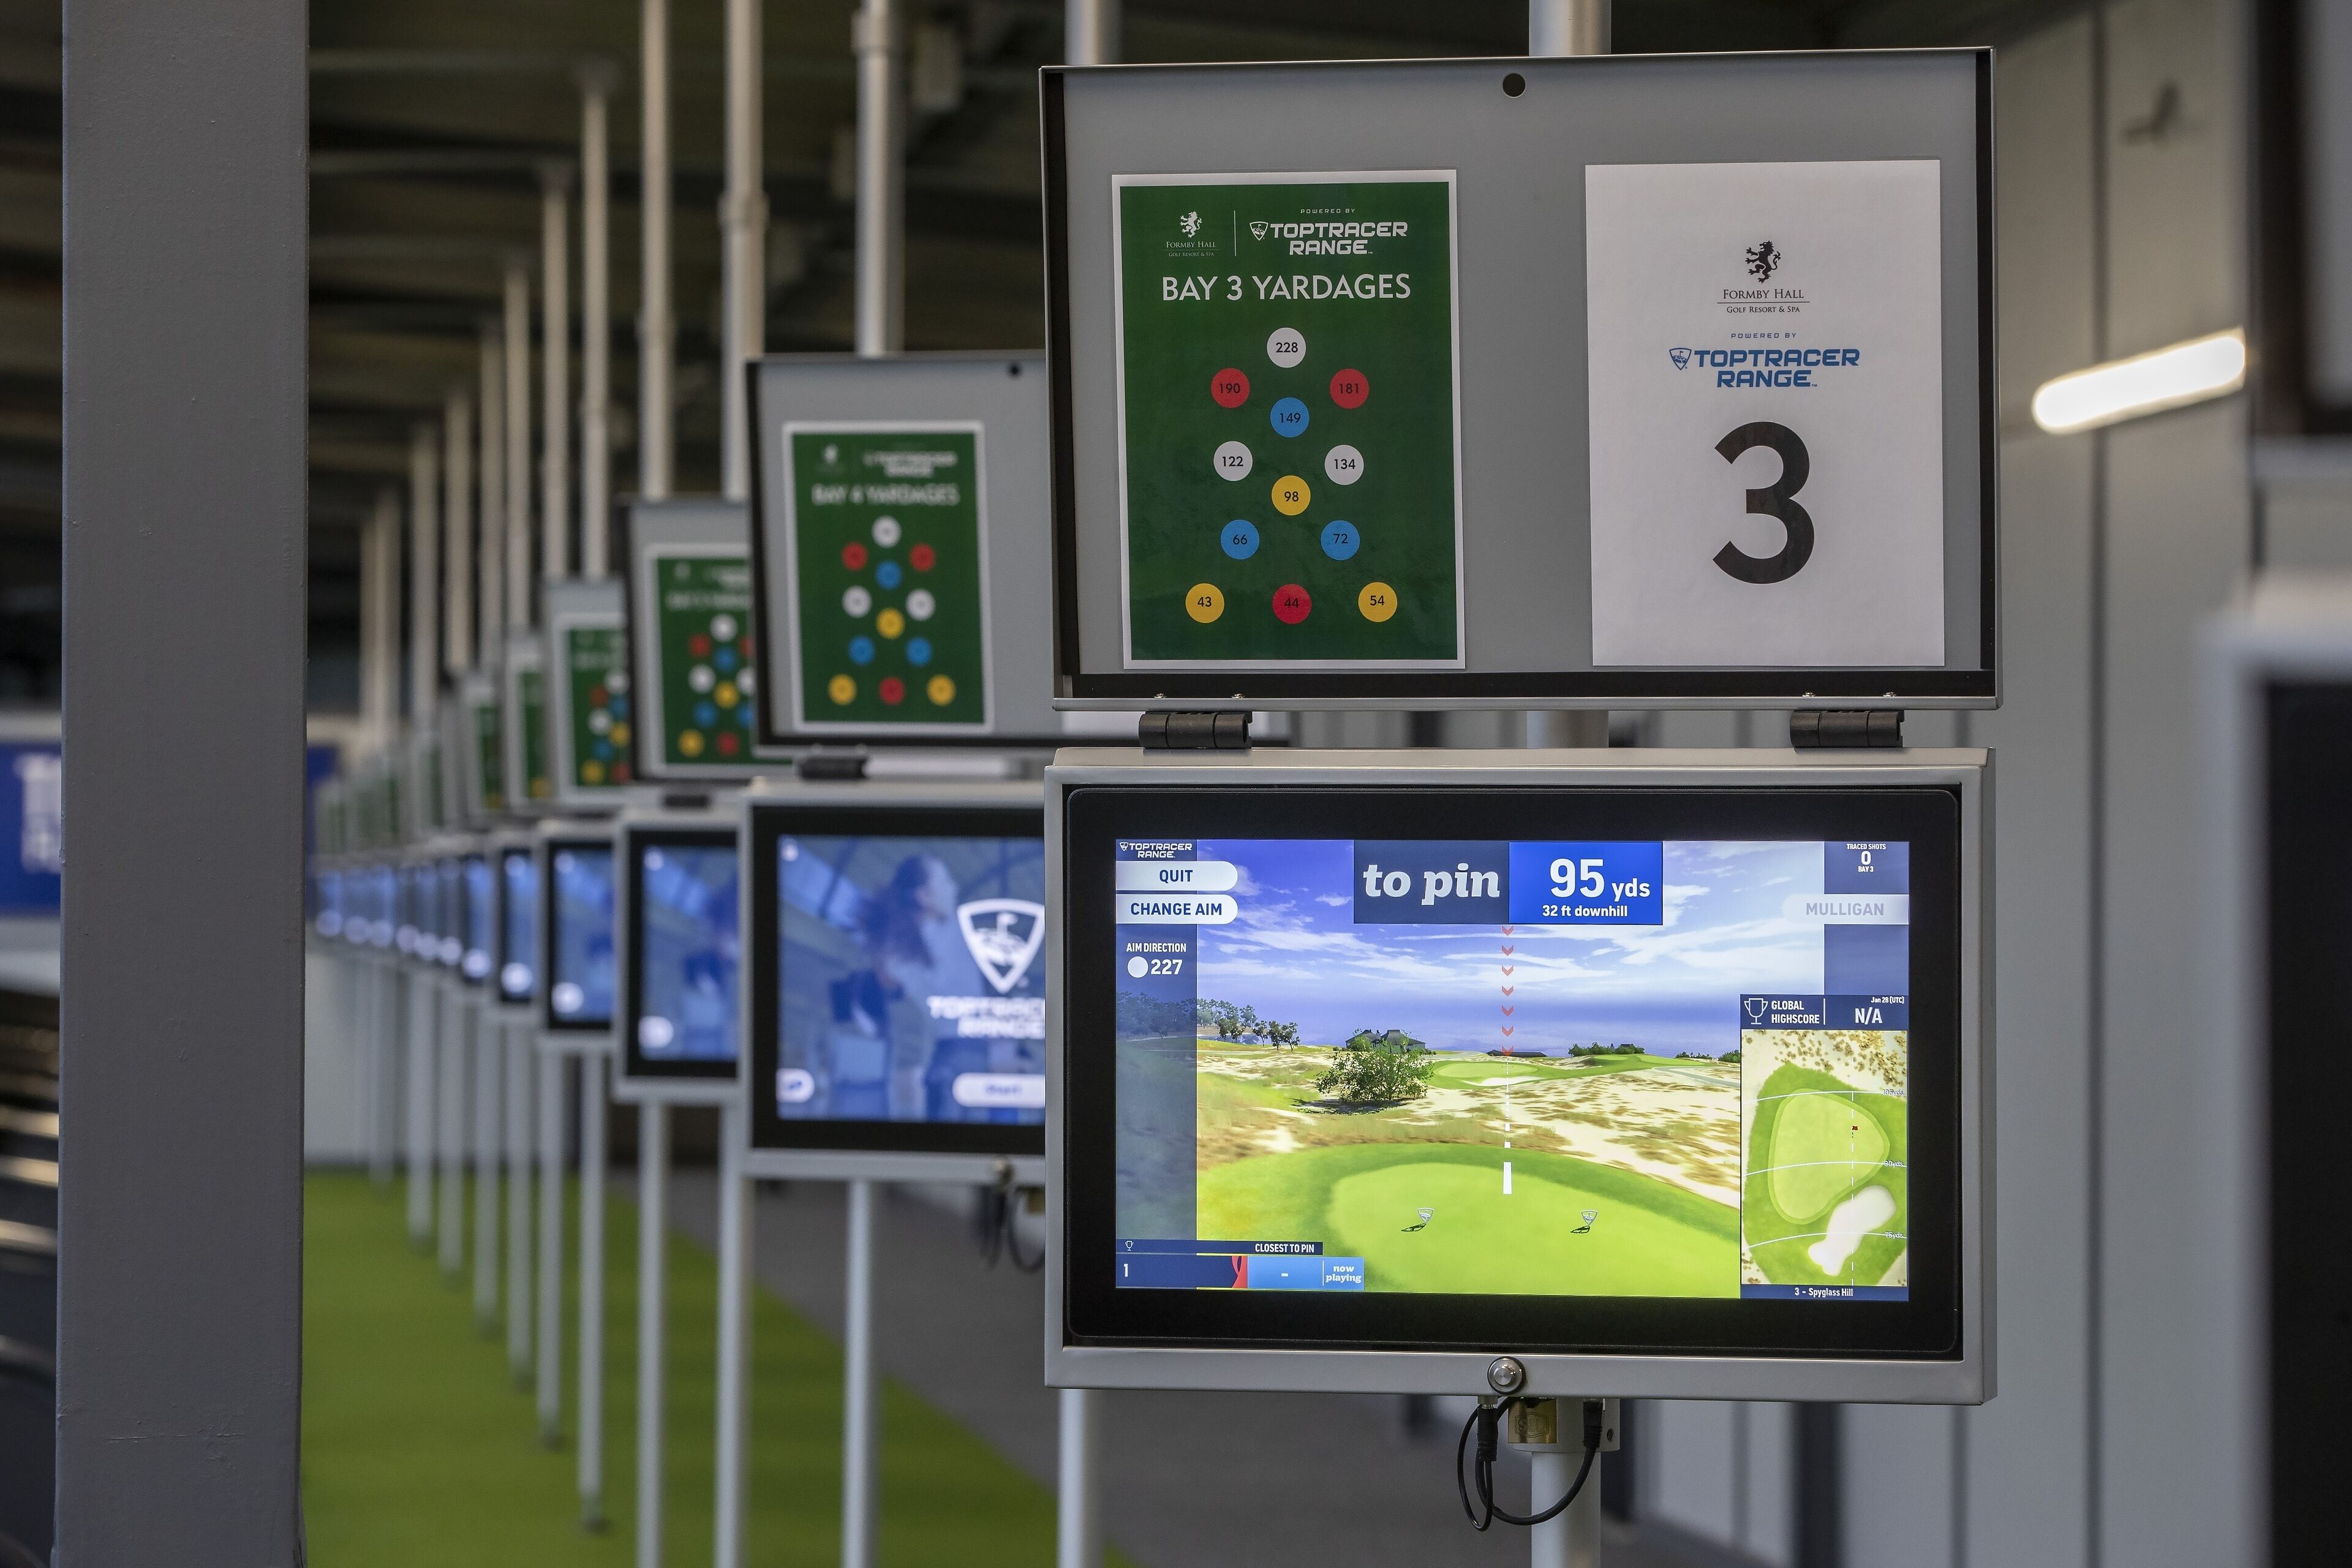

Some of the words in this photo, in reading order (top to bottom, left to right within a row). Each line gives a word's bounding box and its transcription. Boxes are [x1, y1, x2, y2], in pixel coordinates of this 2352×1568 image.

[1270, 222, 1408, 238] TOPTRACER
[1289, 239, 1368, 255] RANGE
[1163, 276, 1218, 301] BAY
[1227, 275, 1242, 300] 3
[1251, 273, 1411, 300] YARDAGES
[1723, 289, 1770, 300] FORMBY
[1774, 288, 1804, 300] HALL
[1275, 342, 1298, 353] 228
[1694, 349, 1860, 368] TOPTRACER
[1716, 370, 1812, 388] RANGE
[1219, 383, 1241, 394] 190
[1339, 383, 1360, 394] 181
[1280, 413, 1301, 424] 149
[1222, 456, 1244, 467] 122
[1334, 459, 1356, 470] 134
[1284, 491, 1299, 502] 98
[1713, 421, 1815, 584] 3
[1232, 534, 1248, 545] 66
[1333, 533, 1348, 544] 72
[1197, 597, 1212, 608] 43
[1284, 598, 1299, 609] 44
[1370, 595, 1385, 606] 54
[1159, 869, 1193, 883] QUIT
[1550, 858, 1605, 898] 95
[1612, 878, 1651, 902] yds
[1363, 864, 1411, 897] to
[1421, 862, 1500, 905] pin
[1131, 902, 1191, 916] CHANGE
[1195, 902, 1222, 916] AIM
[1542, 905, 1558, 917] 32
[1561, 905, 1572, 917] ft
[1574, 905, 1628, 917] downhill
[1806, 903, 1885, 916] MULLIGAN
[1126, 943, 1142, 952] AIM
[1144, 943, 1186, 952] DIRECTION
[1151, 959, 1183, 975] 227
[1771, 1001, 1804, 1011] GLOBAL
[1771, 1014, 1820, 1024] HIGHSCORE
[1855, 1007, 1883, 1025] N/A
[1255, 1243, 1288, 1253] CLOSEST
[1289, 1244, 1300, 1253] TO
[1302, 1244, 1314, 1253] PIN
[1123, 1263, 1129, 1278] 1
[1325, 1273, 1362, 1283] playing
[1809, 1287, 1840, 1298] Spyglass
[1841, 1288, 1853, 1297] Hill
